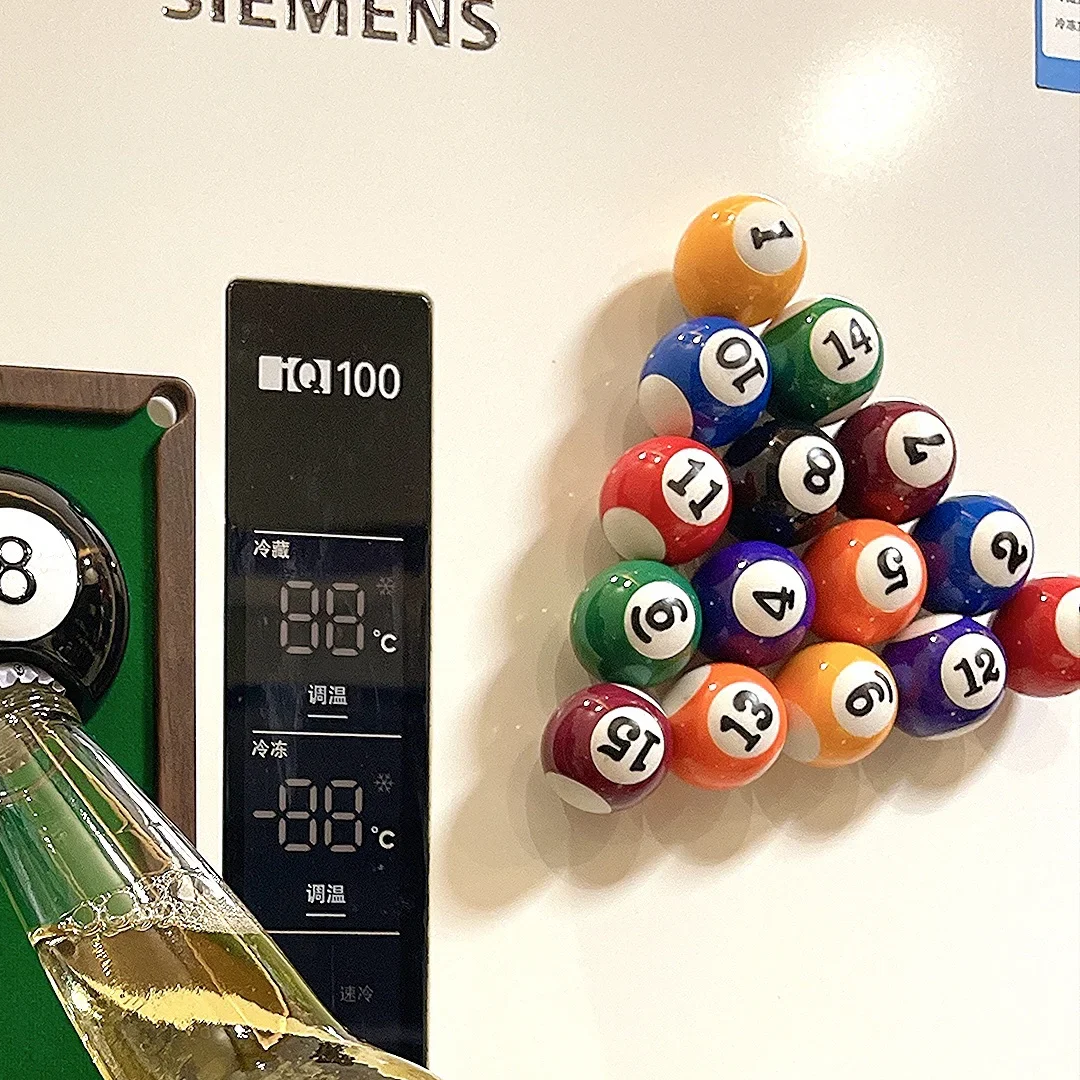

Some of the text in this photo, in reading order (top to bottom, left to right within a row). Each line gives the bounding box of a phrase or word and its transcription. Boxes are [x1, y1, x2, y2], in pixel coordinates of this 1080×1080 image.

[750, 220, 793, 250] 1
[715, 336, 765, 394] 10
[822, 317, 873, 371] 14
[803, 447, 836, 495] 8
[903, 433, 945, 466] 7
[667, 458, 723, 521] 11
[252, 538, 290, 559] 冷藏
[877, 546, 909, 596] 5
[991, 531, 1028, 574] 2
[631, 597, 687, 644] 6
[752, 586, 795, 621] 4
[308, 684, 348, 706] 调温
[954, 647, 1001, 698] 12
[720, 689, 773, 752] 13
[251, 739, 289, 759] 冷冻
[596, 716, 661, 772] 15
[306, 883, 347, 904] 调温
[340, 984, 374, 1003] 速冷
